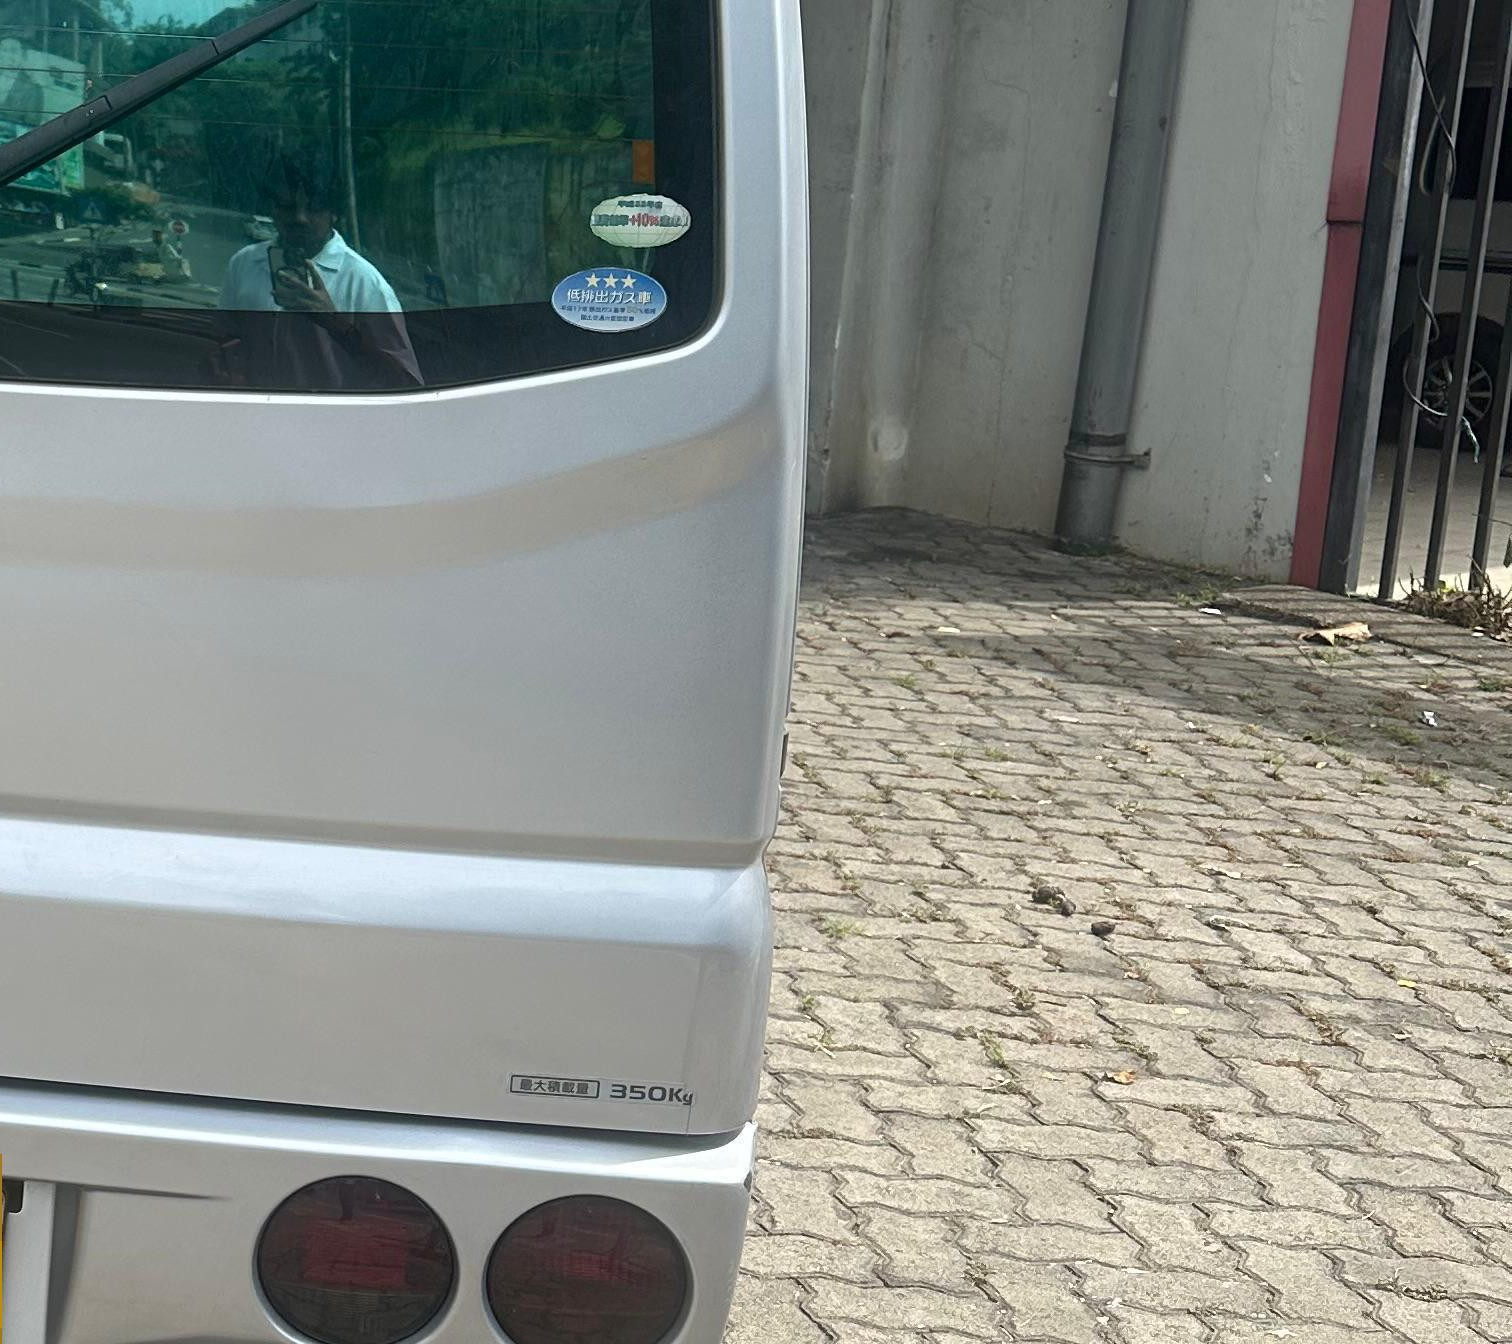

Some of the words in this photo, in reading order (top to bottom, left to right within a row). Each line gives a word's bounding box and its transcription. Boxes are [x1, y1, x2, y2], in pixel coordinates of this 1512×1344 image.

[567, 288, 652, 305] 低排出ガス車
[519, 1078, 589, 1095] 最大積載量
[609, 1083, 694, 1106] 350Kg
